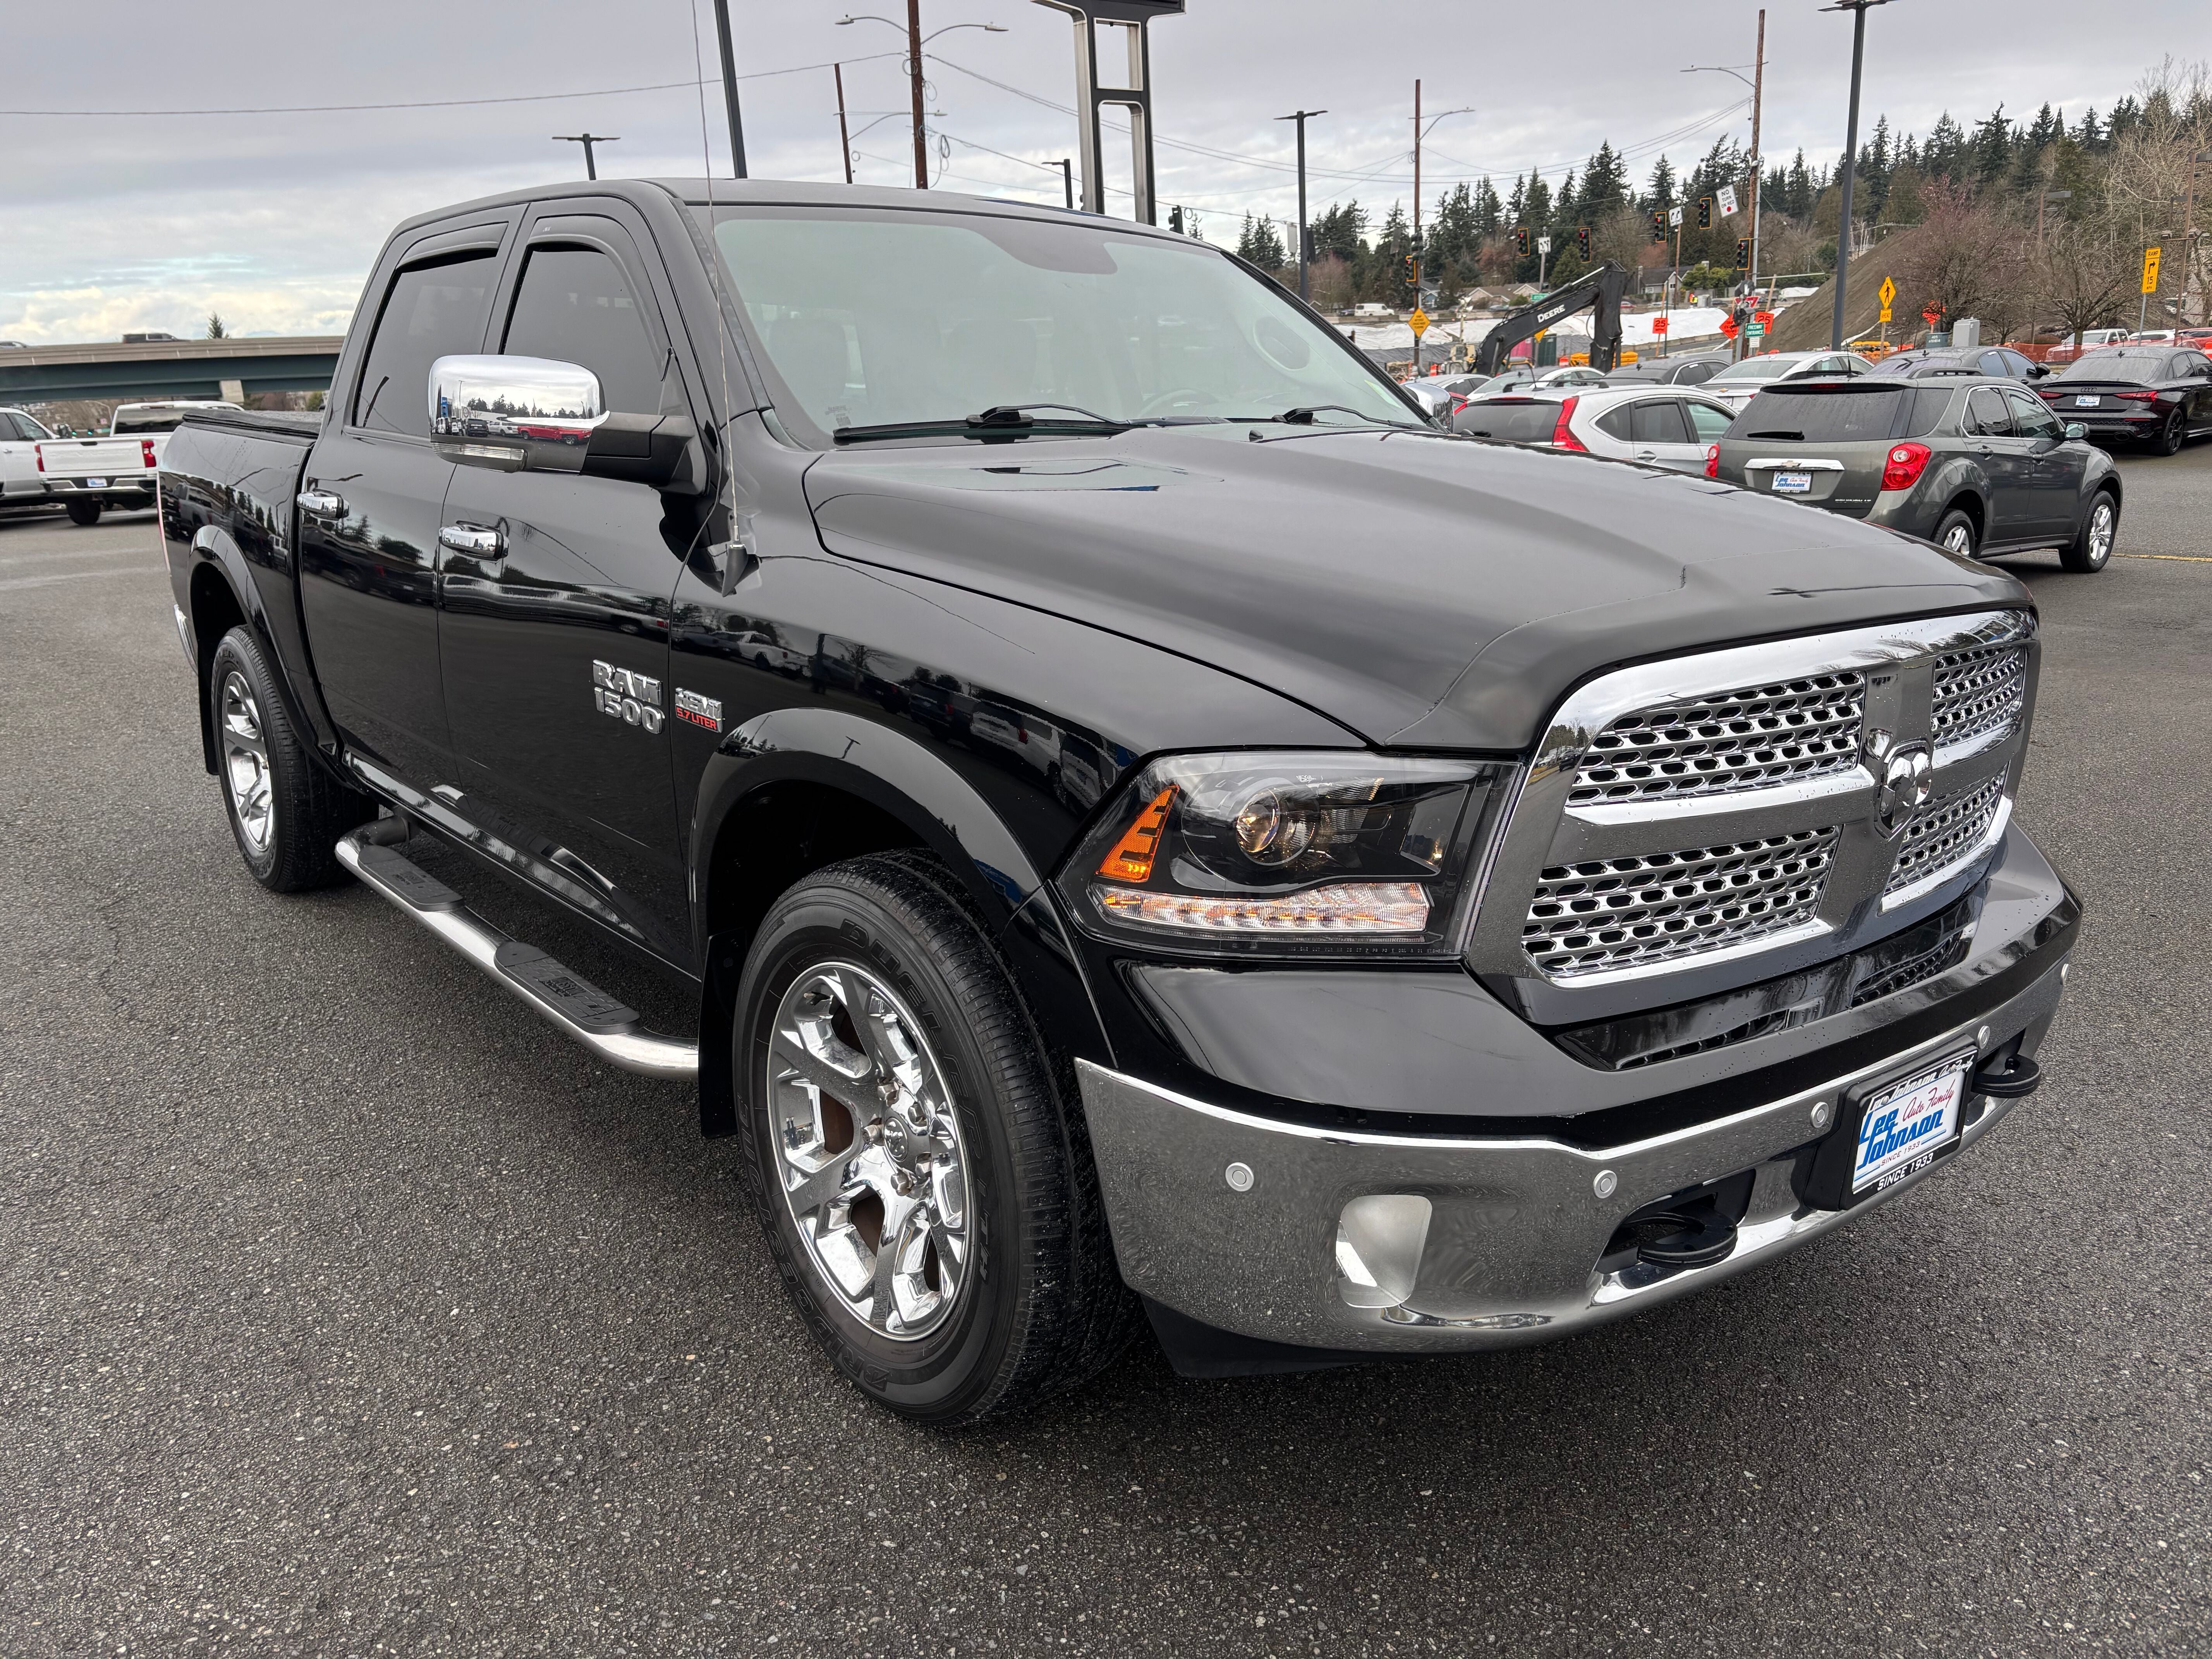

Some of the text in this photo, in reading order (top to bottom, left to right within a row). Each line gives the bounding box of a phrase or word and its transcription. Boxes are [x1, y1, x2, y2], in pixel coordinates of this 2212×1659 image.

[2147, 276, 2153, 284] 15
[1537, 304, 1565, 323] DEERE
[593, 659, 663, 706] RAM
[594, 687, 665, 734] 1500
[675, 688, 721, 720] HEMI
[677, 707, 716, 730] 5.7 LITER
[839, 919, 984, 1159] DUELER
[1888, 1072, 1937, 1101] Johnson
[1903, 1097, 1925, 1122] Auto
[1925, 1079, 1955, 1111] Family
[1856, 1109, 1944, 1171] Johnson
[1858, 1108, 1899, 1145] Lee
[1877, 1152, 1934, 1191] SINCE 1933
[1881, 1141, 1920, 1166] SINCE 1933
[737, 1092, 891, 1393] BRIDGESTONE
